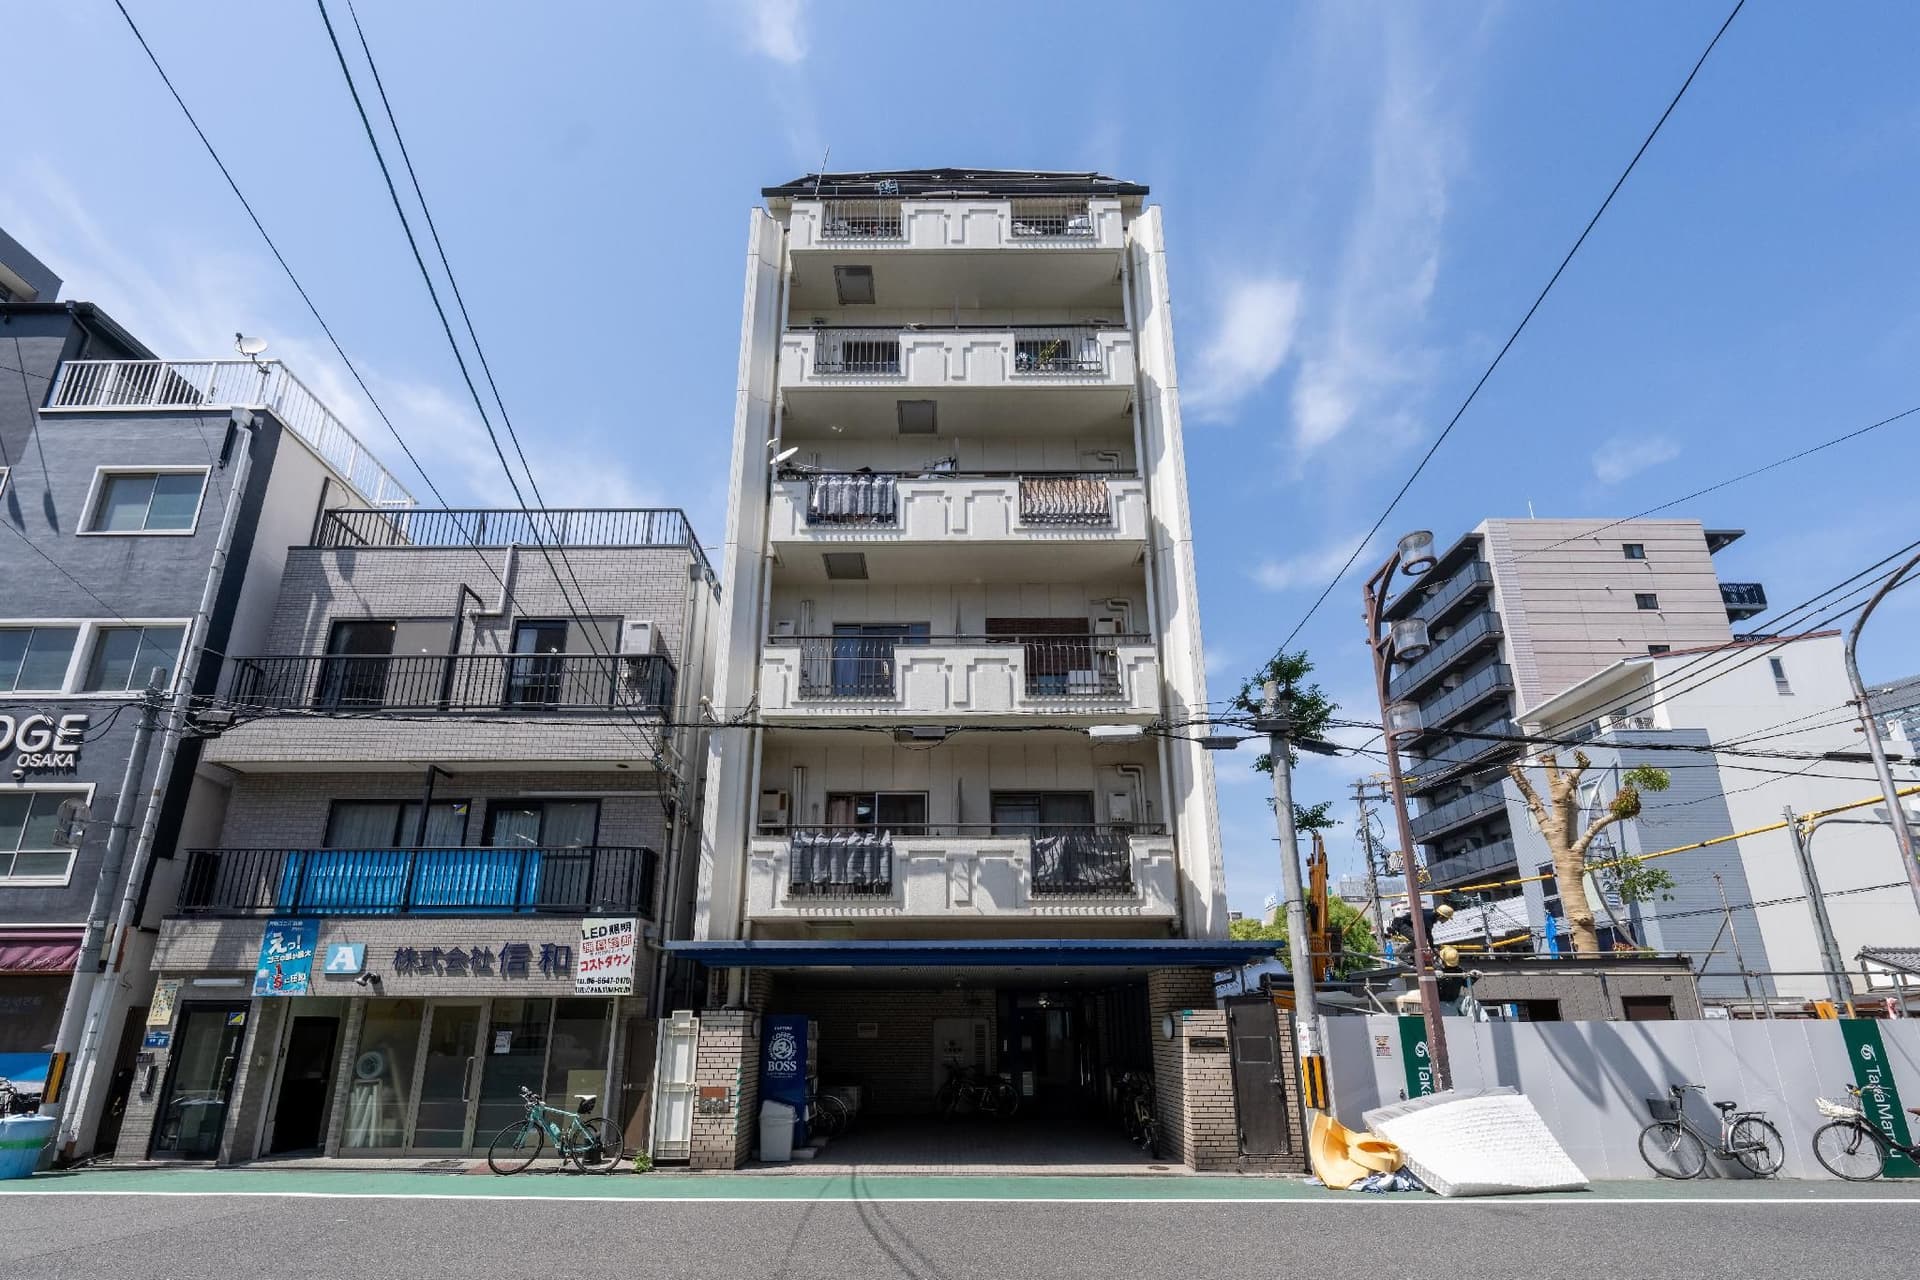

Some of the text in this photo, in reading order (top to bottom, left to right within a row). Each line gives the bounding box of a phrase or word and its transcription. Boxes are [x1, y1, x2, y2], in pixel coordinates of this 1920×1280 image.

[17, 753, 75, 767] OSAKA
[327, 946, 357, 970] A
[392, 942, 570, 972] 株式会社信和
[580, 954, 631, 972] コストダウン
[768, 1060, 797, 1071] BOSS
